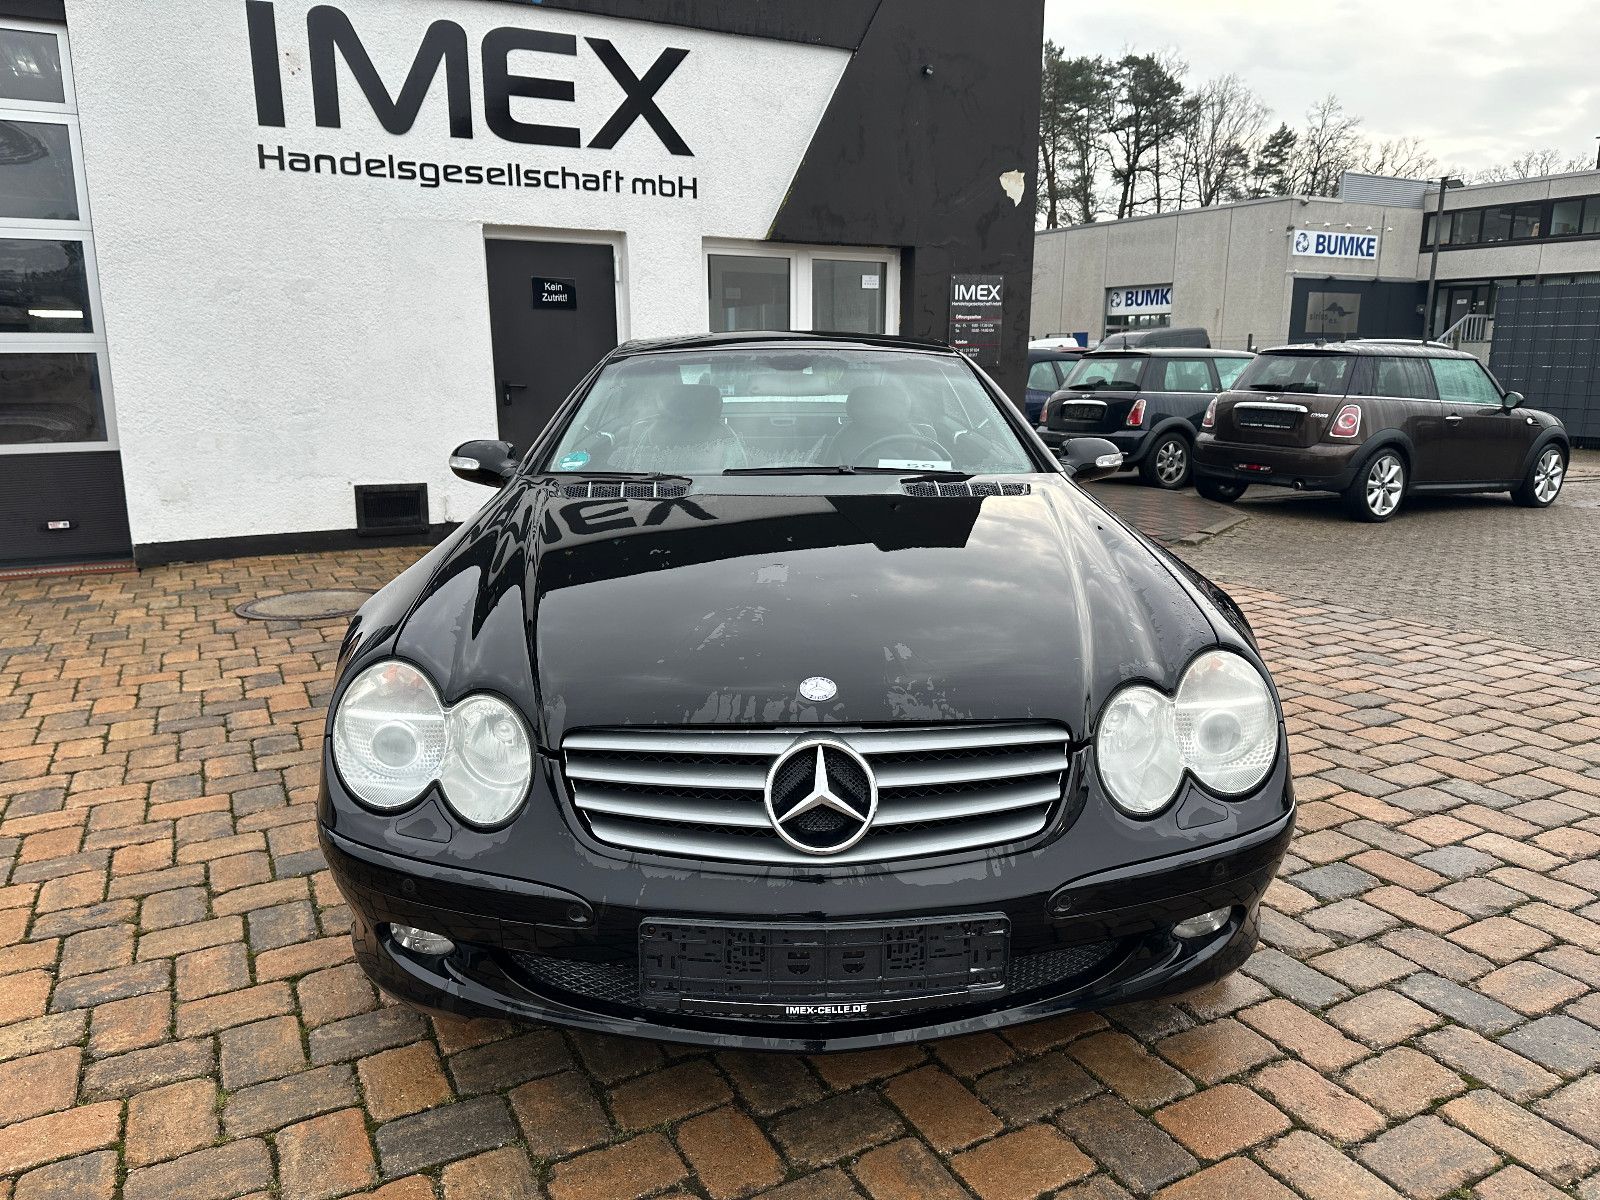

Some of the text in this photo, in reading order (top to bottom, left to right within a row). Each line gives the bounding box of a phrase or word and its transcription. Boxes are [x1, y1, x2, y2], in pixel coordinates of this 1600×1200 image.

[246, 0, 695, 157] IMEX
[257, 144, 698, 199] Handelsgesellschaft mbH
[1315, 233, 1376, 257] BUMKE
[544, 282, 563, 291] Kein
[954, 284, 1001, 300] IMEX
[542, 293, 568, 302] Zutritt!
[1124, 288, 1173, 307] BUMK
[785, 1005, 867, 1014] IMEX-CELLE.DE
